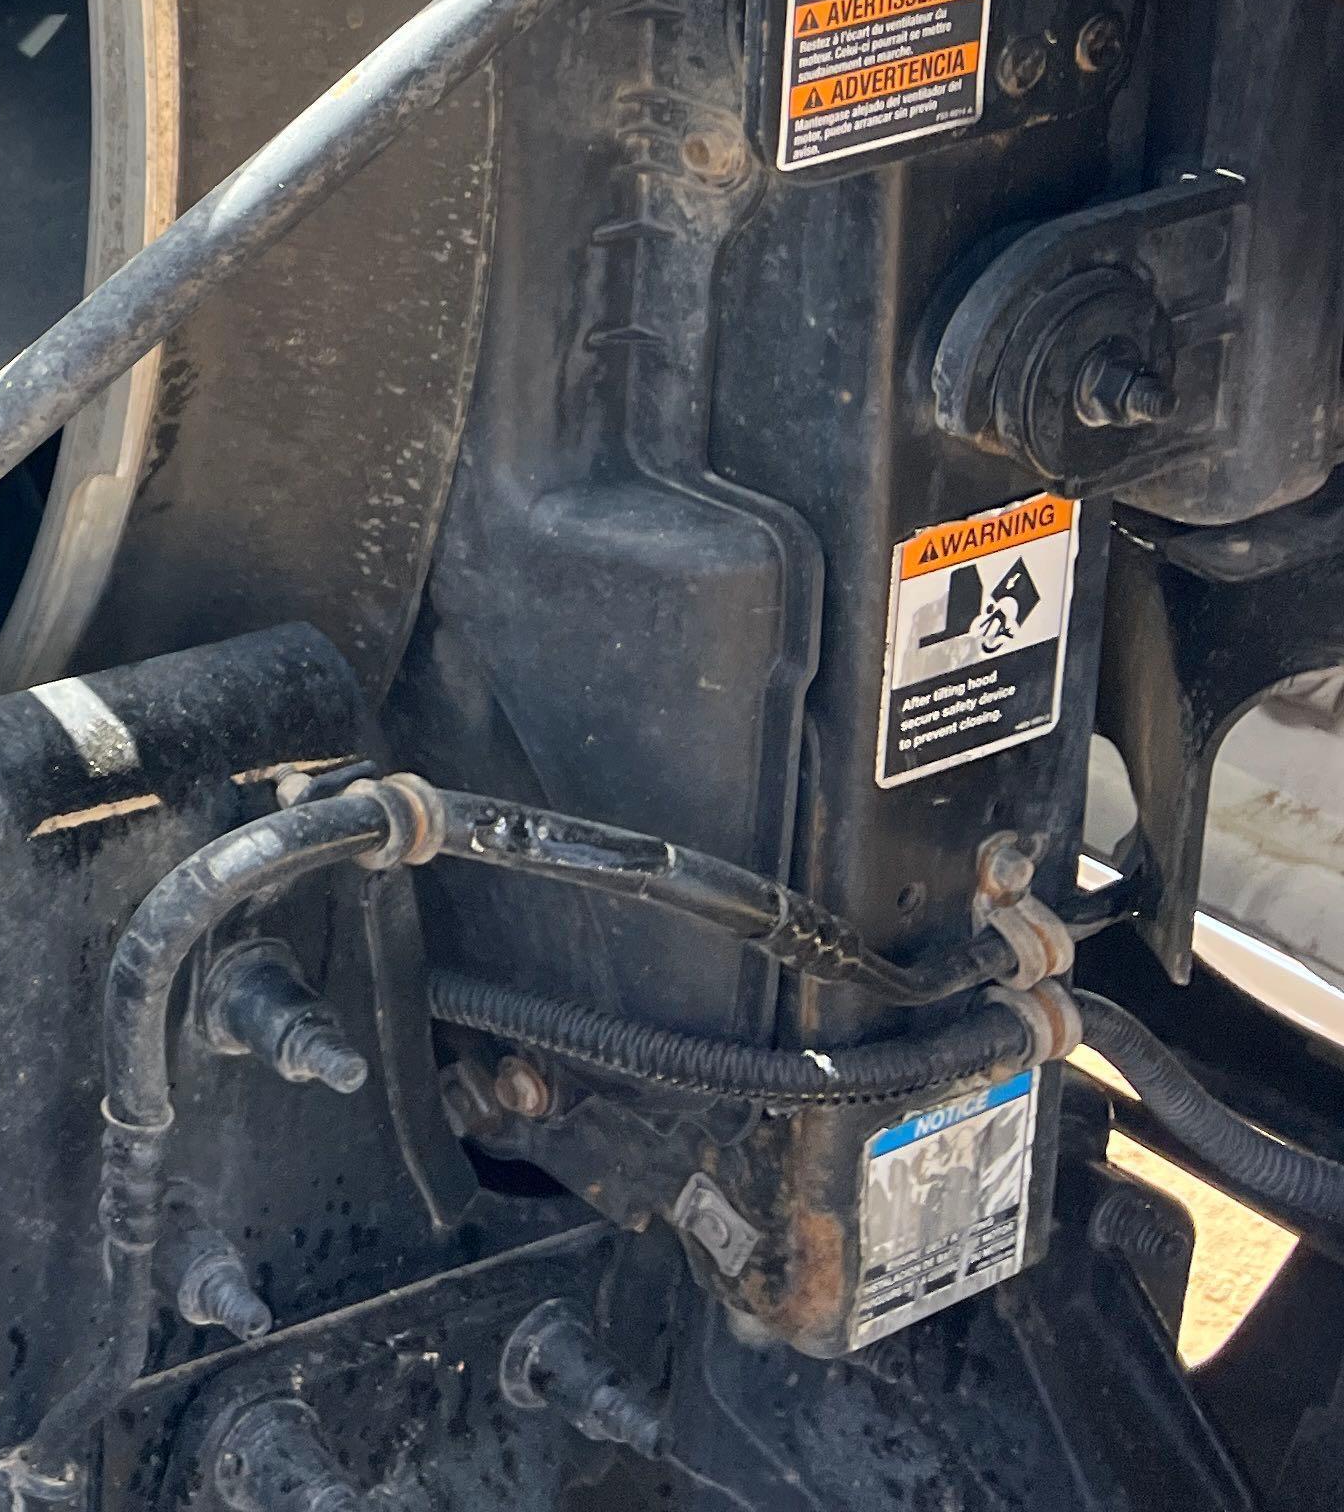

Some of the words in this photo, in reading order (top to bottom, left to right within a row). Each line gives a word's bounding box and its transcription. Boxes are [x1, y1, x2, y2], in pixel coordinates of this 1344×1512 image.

[831, 48, 965, 104] ADVERTENCIA
[885, 94, 902, 109] del
[947, 78, 962, 93] del
[824, 121, 853, 141] puede
[853, 111, 893, 131] arrancar
[894, 106, 908, 120] sin
[909, 99, 938, 119] previo
[940, 504, 1055, 557] WARNING
[900, 710, 940, 732] secure
[941, 697, 978, 717] safety
[978, 684, 1016, 706] device
[902, 694, 932, 713] After
[932, 683, 966, 702] tilting
[967, 670, 998, 691] hood
[898, 738, 912, 752] to
[913, 721, 958, 749] prevent
[913, 1090, 989, 1138] NOTICE
